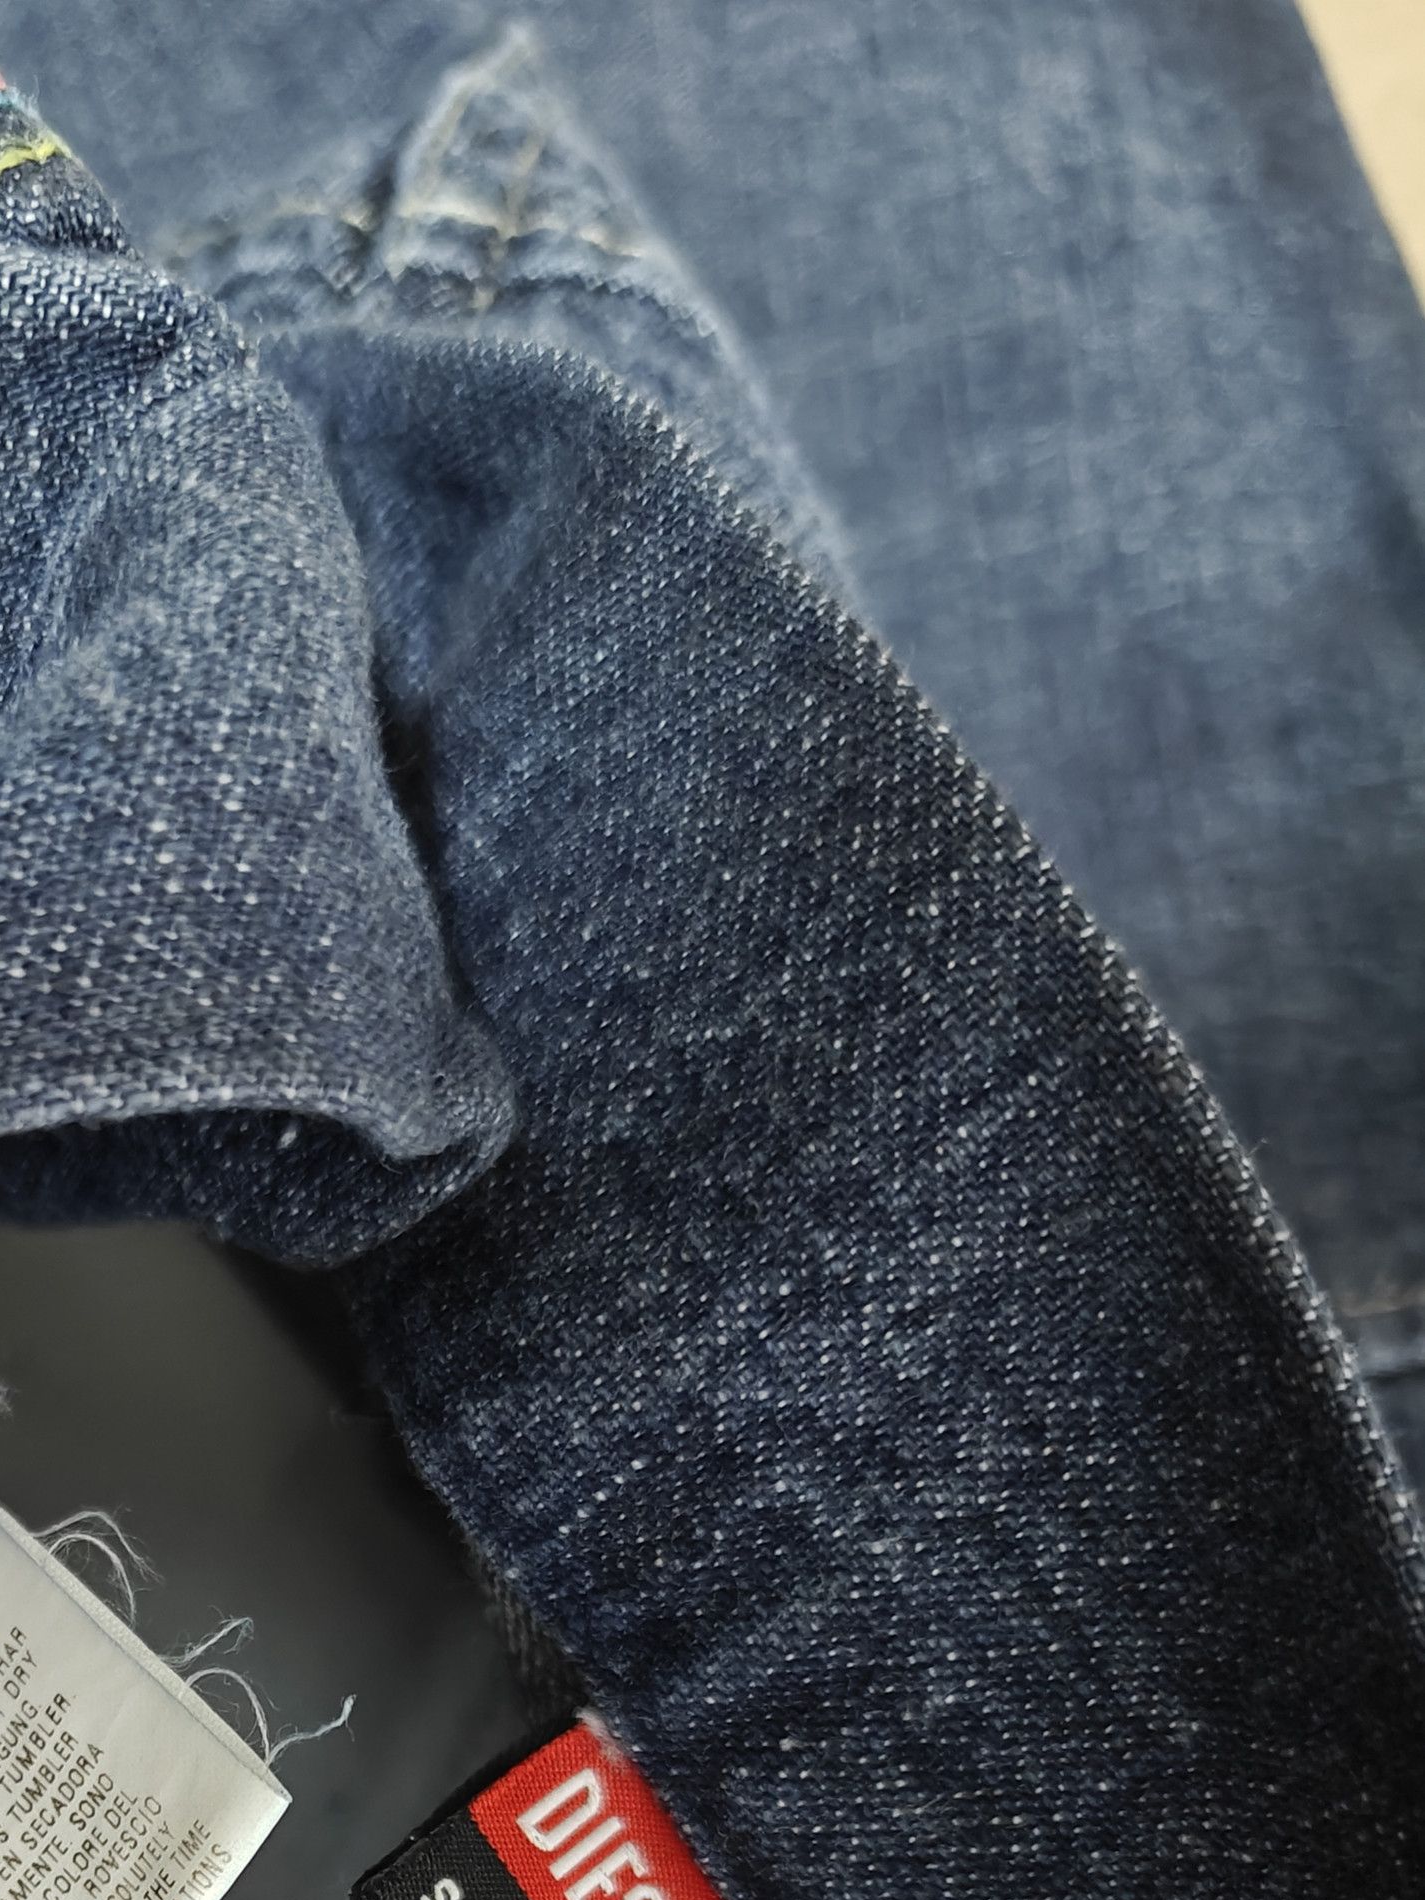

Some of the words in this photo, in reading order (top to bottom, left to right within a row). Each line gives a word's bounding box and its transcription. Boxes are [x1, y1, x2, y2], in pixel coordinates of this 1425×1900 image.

[2, 1648, 39, 1700] DRY
[5, 1730, 79, 1824] TUMBLER
[19, 1741, 104, 1850] SECADORA
[67, 1771, 115, 1831] SONO
[102, 1788, 139, 1829] DEL
[81, 1794, 162, 1898] ROVESCIO
[169, 1818, 212, 1870] TIME
